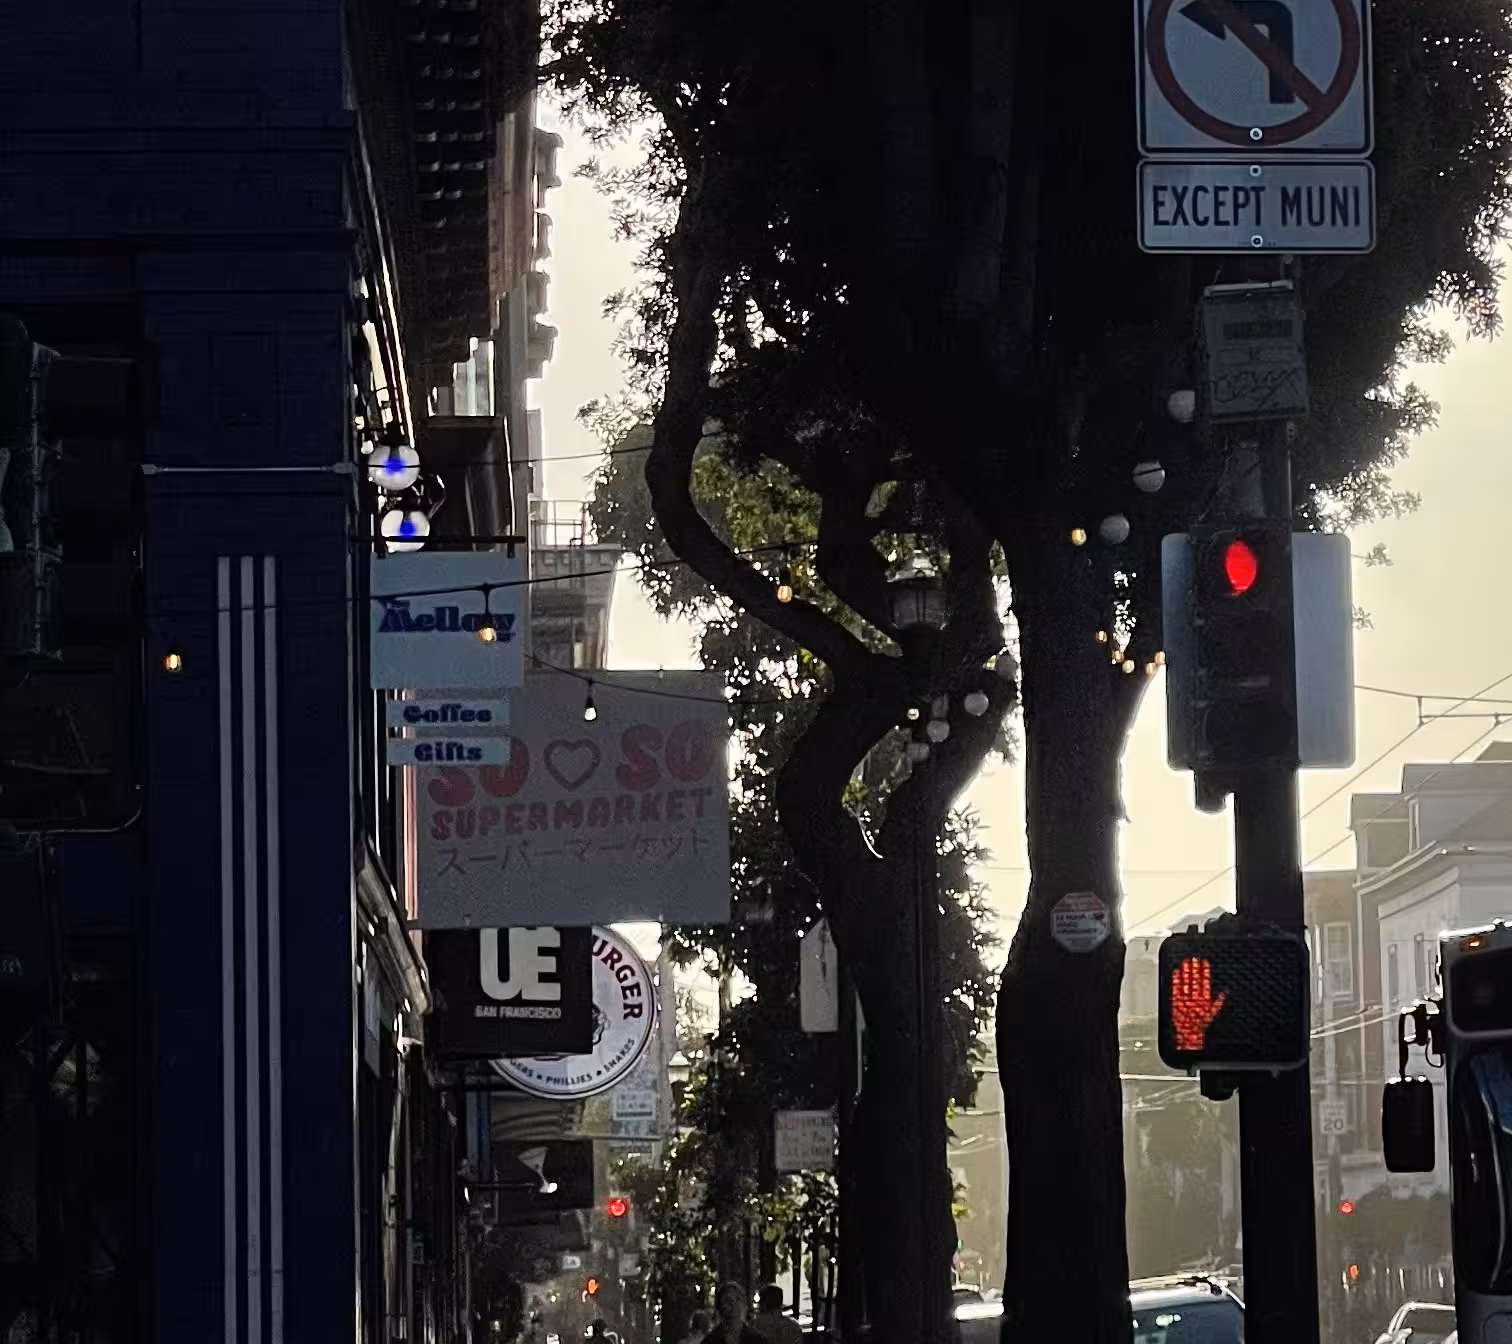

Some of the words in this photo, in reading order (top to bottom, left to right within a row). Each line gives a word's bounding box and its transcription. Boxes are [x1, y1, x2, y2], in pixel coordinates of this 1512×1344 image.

[1152, 184, 1266, 227] EXCEPT
[1281, 185, 1361, 227] MUNI
[403, 703, 492, 723] Coffee
[414, 741, 483, 762] Gifts
[430, 786, 712, 841] SUPERMARKET
[474, 1004, 498, 1017] SAN
[499, 1005, 562, 1020] FRANCISCO
[546, 1072, 593, 1087] PHILLIES
[603, 1037, 635, 1073] SHAKES
